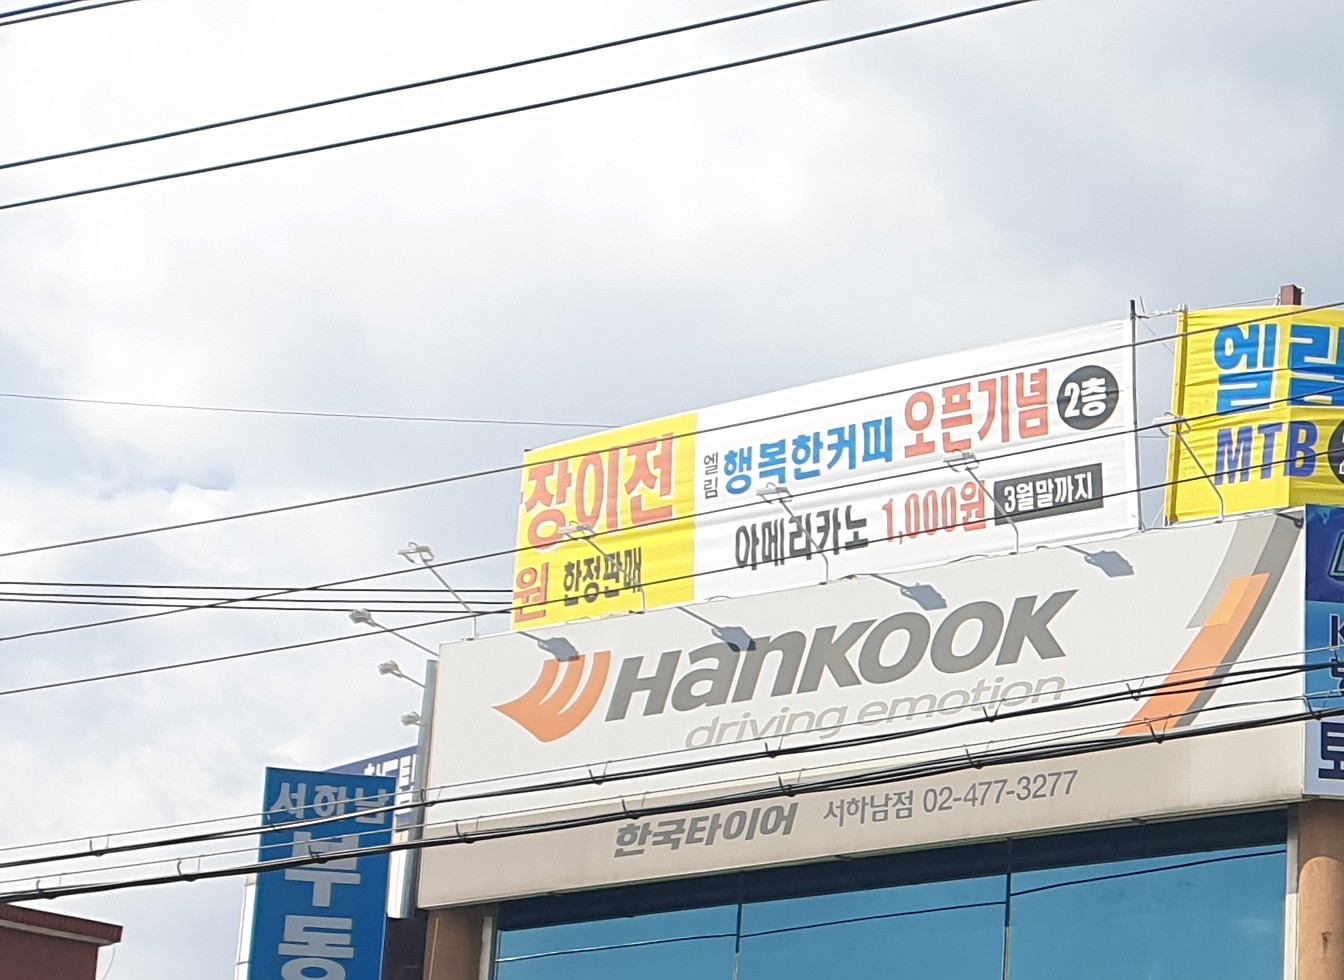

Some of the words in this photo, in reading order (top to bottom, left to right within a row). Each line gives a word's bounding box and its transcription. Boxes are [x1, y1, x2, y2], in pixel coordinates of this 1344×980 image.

[723, 416, 895, 496] 행복한커피
[903, 366, 1050, 459] 오픈기념
[1061, 376, 1112, 421] 2층
[1215, 424, 1319, 487] MTB
[522, 433, 676, 553] 장이전
[734, 503, 870, 572] 아메리카노
[881, 480, 988, 546] 1,000원
[1002, 472, 1095, 518] 3월말까지
[562, 546, 643, 607] 한정판매
[685, 701, 845, 750] driving
[855, 675, 1066, 728] emotion
[270, 782, 391, 825] 서하남
[614, 802, 799, 859] 한국타이어
[823, 790, 915, 829] 서하남점
[923, 769, 1078, 813] 02-477-3277
